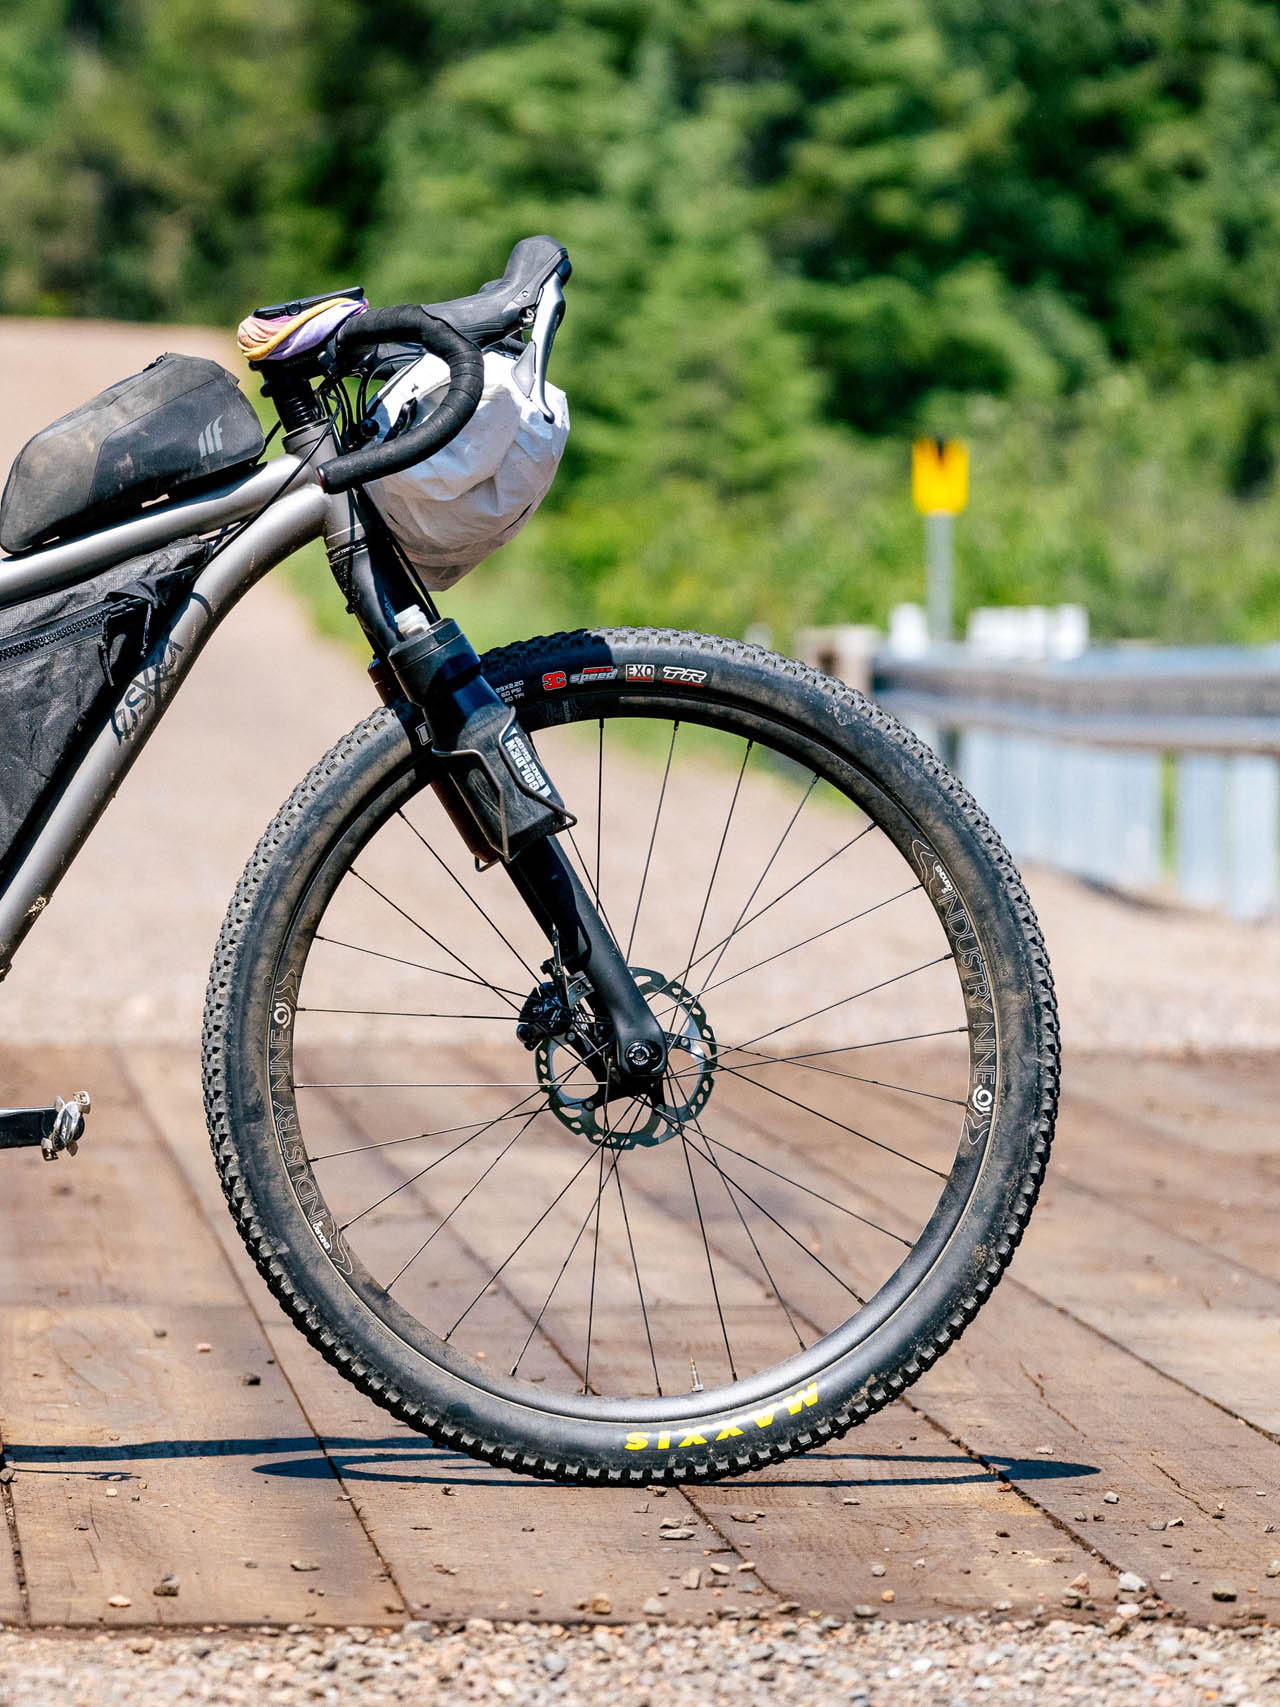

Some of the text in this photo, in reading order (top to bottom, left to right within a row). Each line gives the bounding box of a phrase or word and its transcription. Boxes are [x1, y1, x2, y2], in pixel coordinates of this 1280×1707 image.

[542, 669, 618, 690] 3C speed
[626, 665, 653, 677] EXO
[663, 666, 707, 683] TR
[505, 739, 540, 790] GOLDEN
[514, 736, 546, 787] BIKE SHOP
[936, 889, 993, 1013] INDUSTRY
[972, 1022, 996, 1084] NINE
[270, 1029, 328, 1226] INDUSTRY NINE
[623, 1380, 819, 1452] MAXXIS
